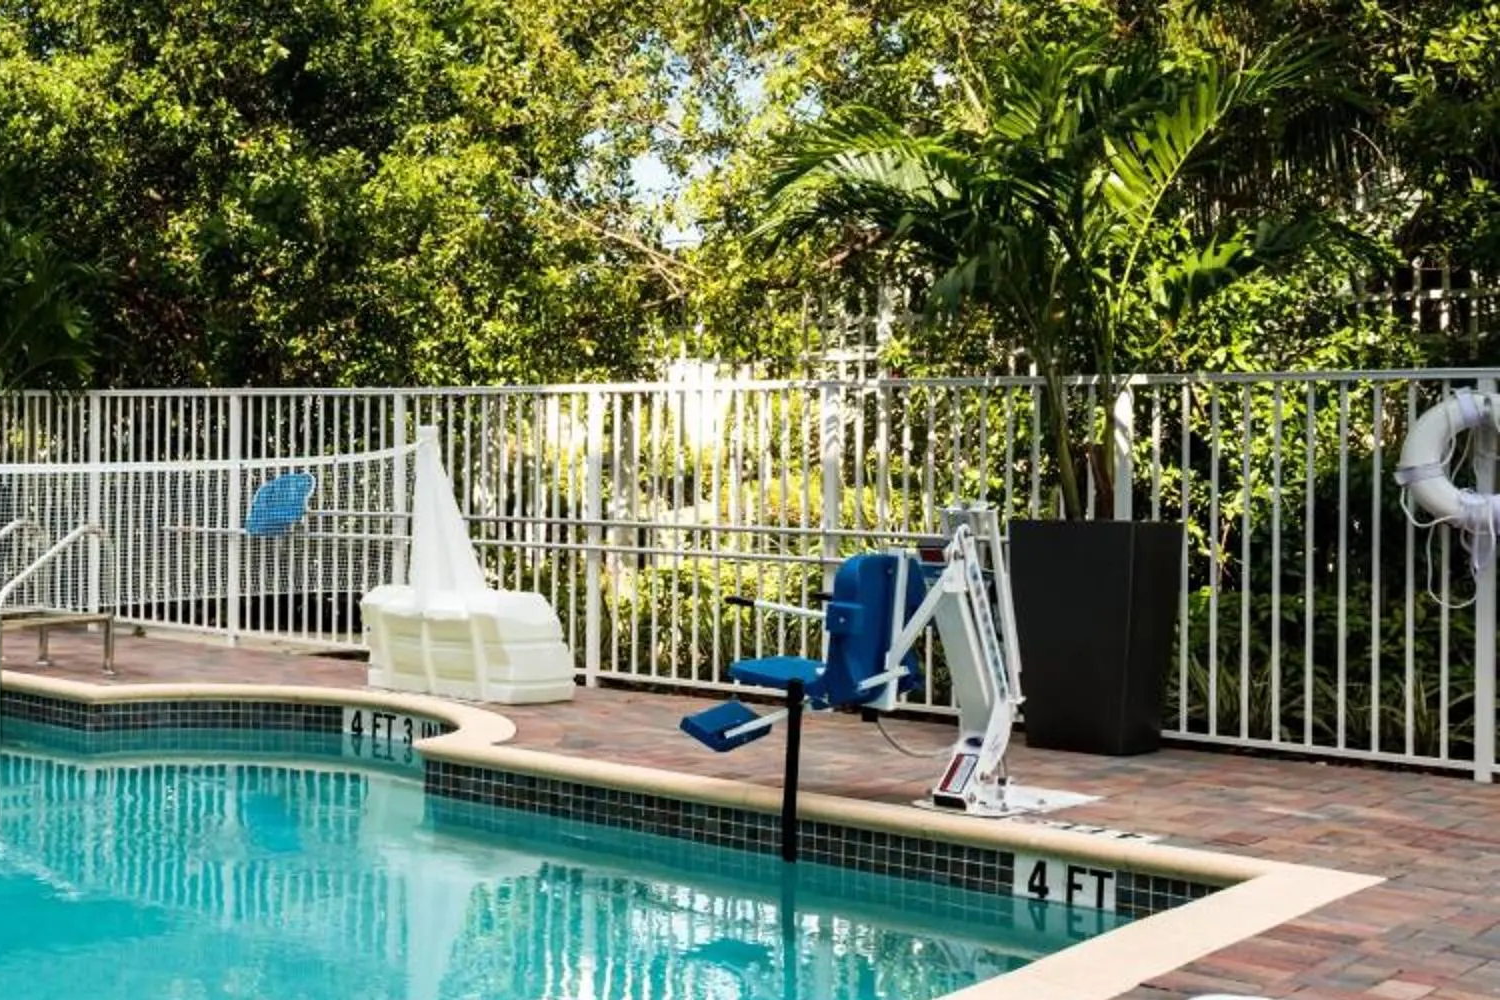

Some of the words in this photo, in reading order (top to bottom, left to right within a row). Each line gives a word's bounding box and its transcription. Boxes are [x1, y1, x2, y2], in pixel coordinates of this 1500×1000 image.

[351, 710, 363, 735] 4
[373, 712, 397, 738] FT
[404, 717, 412, 746] 3
[1028, 859, 1049, 899] 4
[1066, 865, 1114, 908] FT
